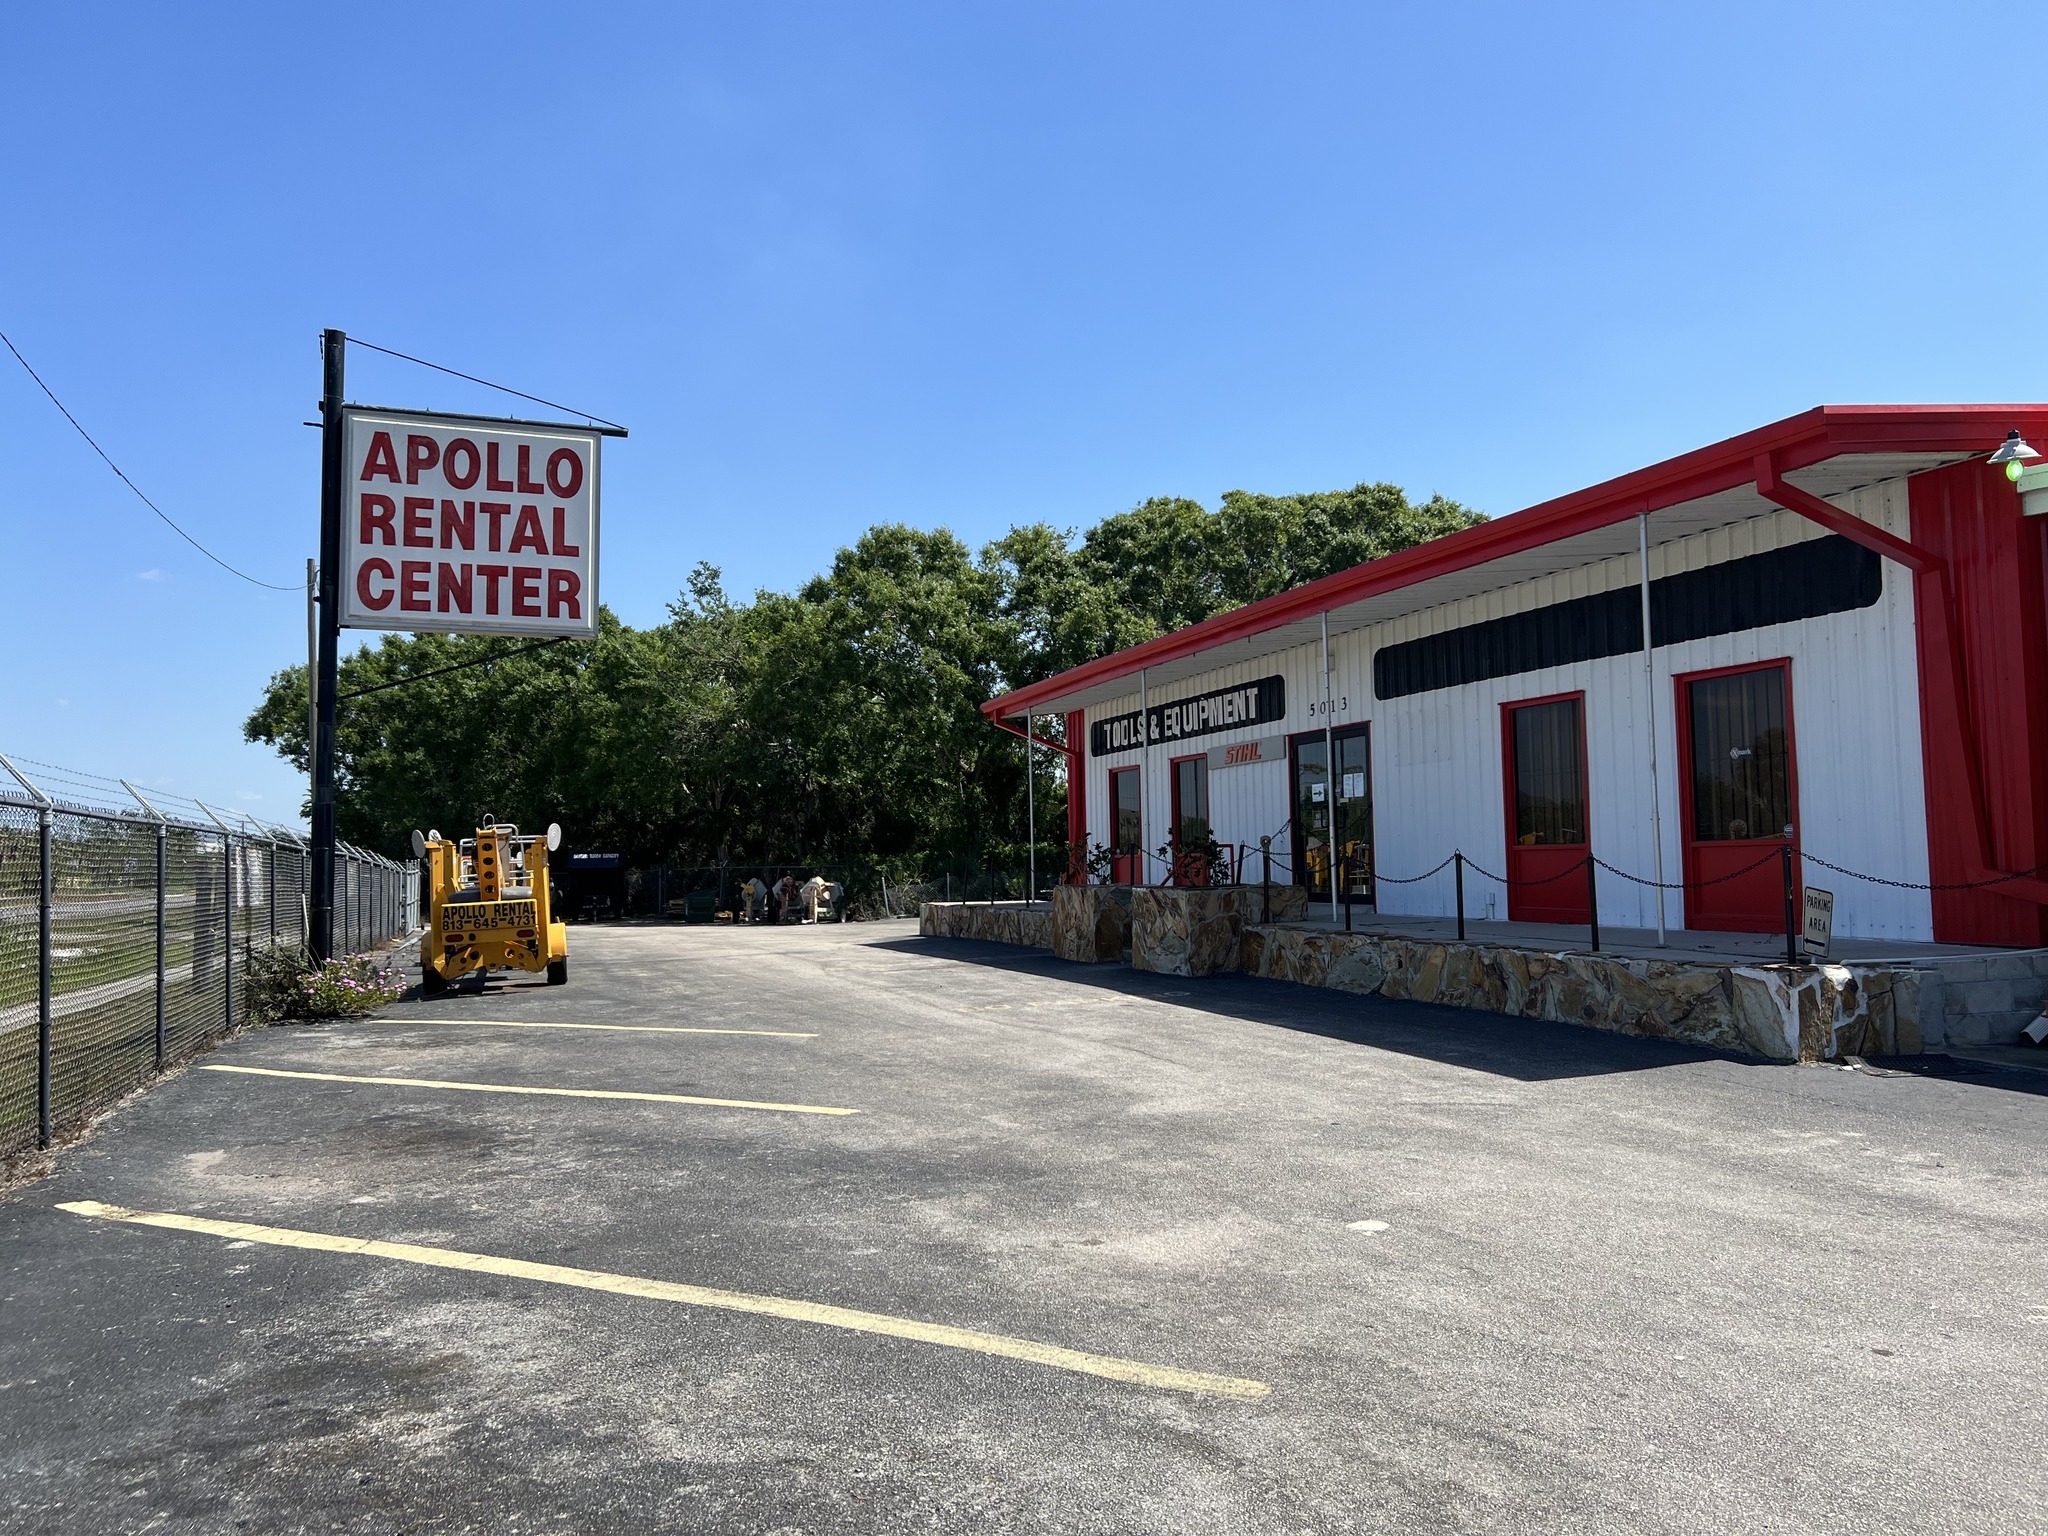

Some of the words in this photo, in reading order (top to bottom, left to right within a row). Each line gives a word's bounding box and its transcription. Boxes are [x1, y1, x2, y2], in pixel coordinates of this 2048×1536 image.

[360, 431, 583, 499] APOLLO
[360, 493, 580, 558] RENTAL
[356, 557, 582, 620] CENTER
[1150, 714, 1160, 740] &
[1163, 687, 1259, 738] EQUIPMENT
[1309, 696, 1348, 717] 5013
[1225, 742, 1262, 765] STIHL
[442, 904, 487, 921] APOLLO
[493, 901, 536, 918] RENTAL
[1806, 895, 1831, 913] PARKING
[442, 915, 536, 931] 813-645-4731
[1808, 917, 1826, 933] AREA
